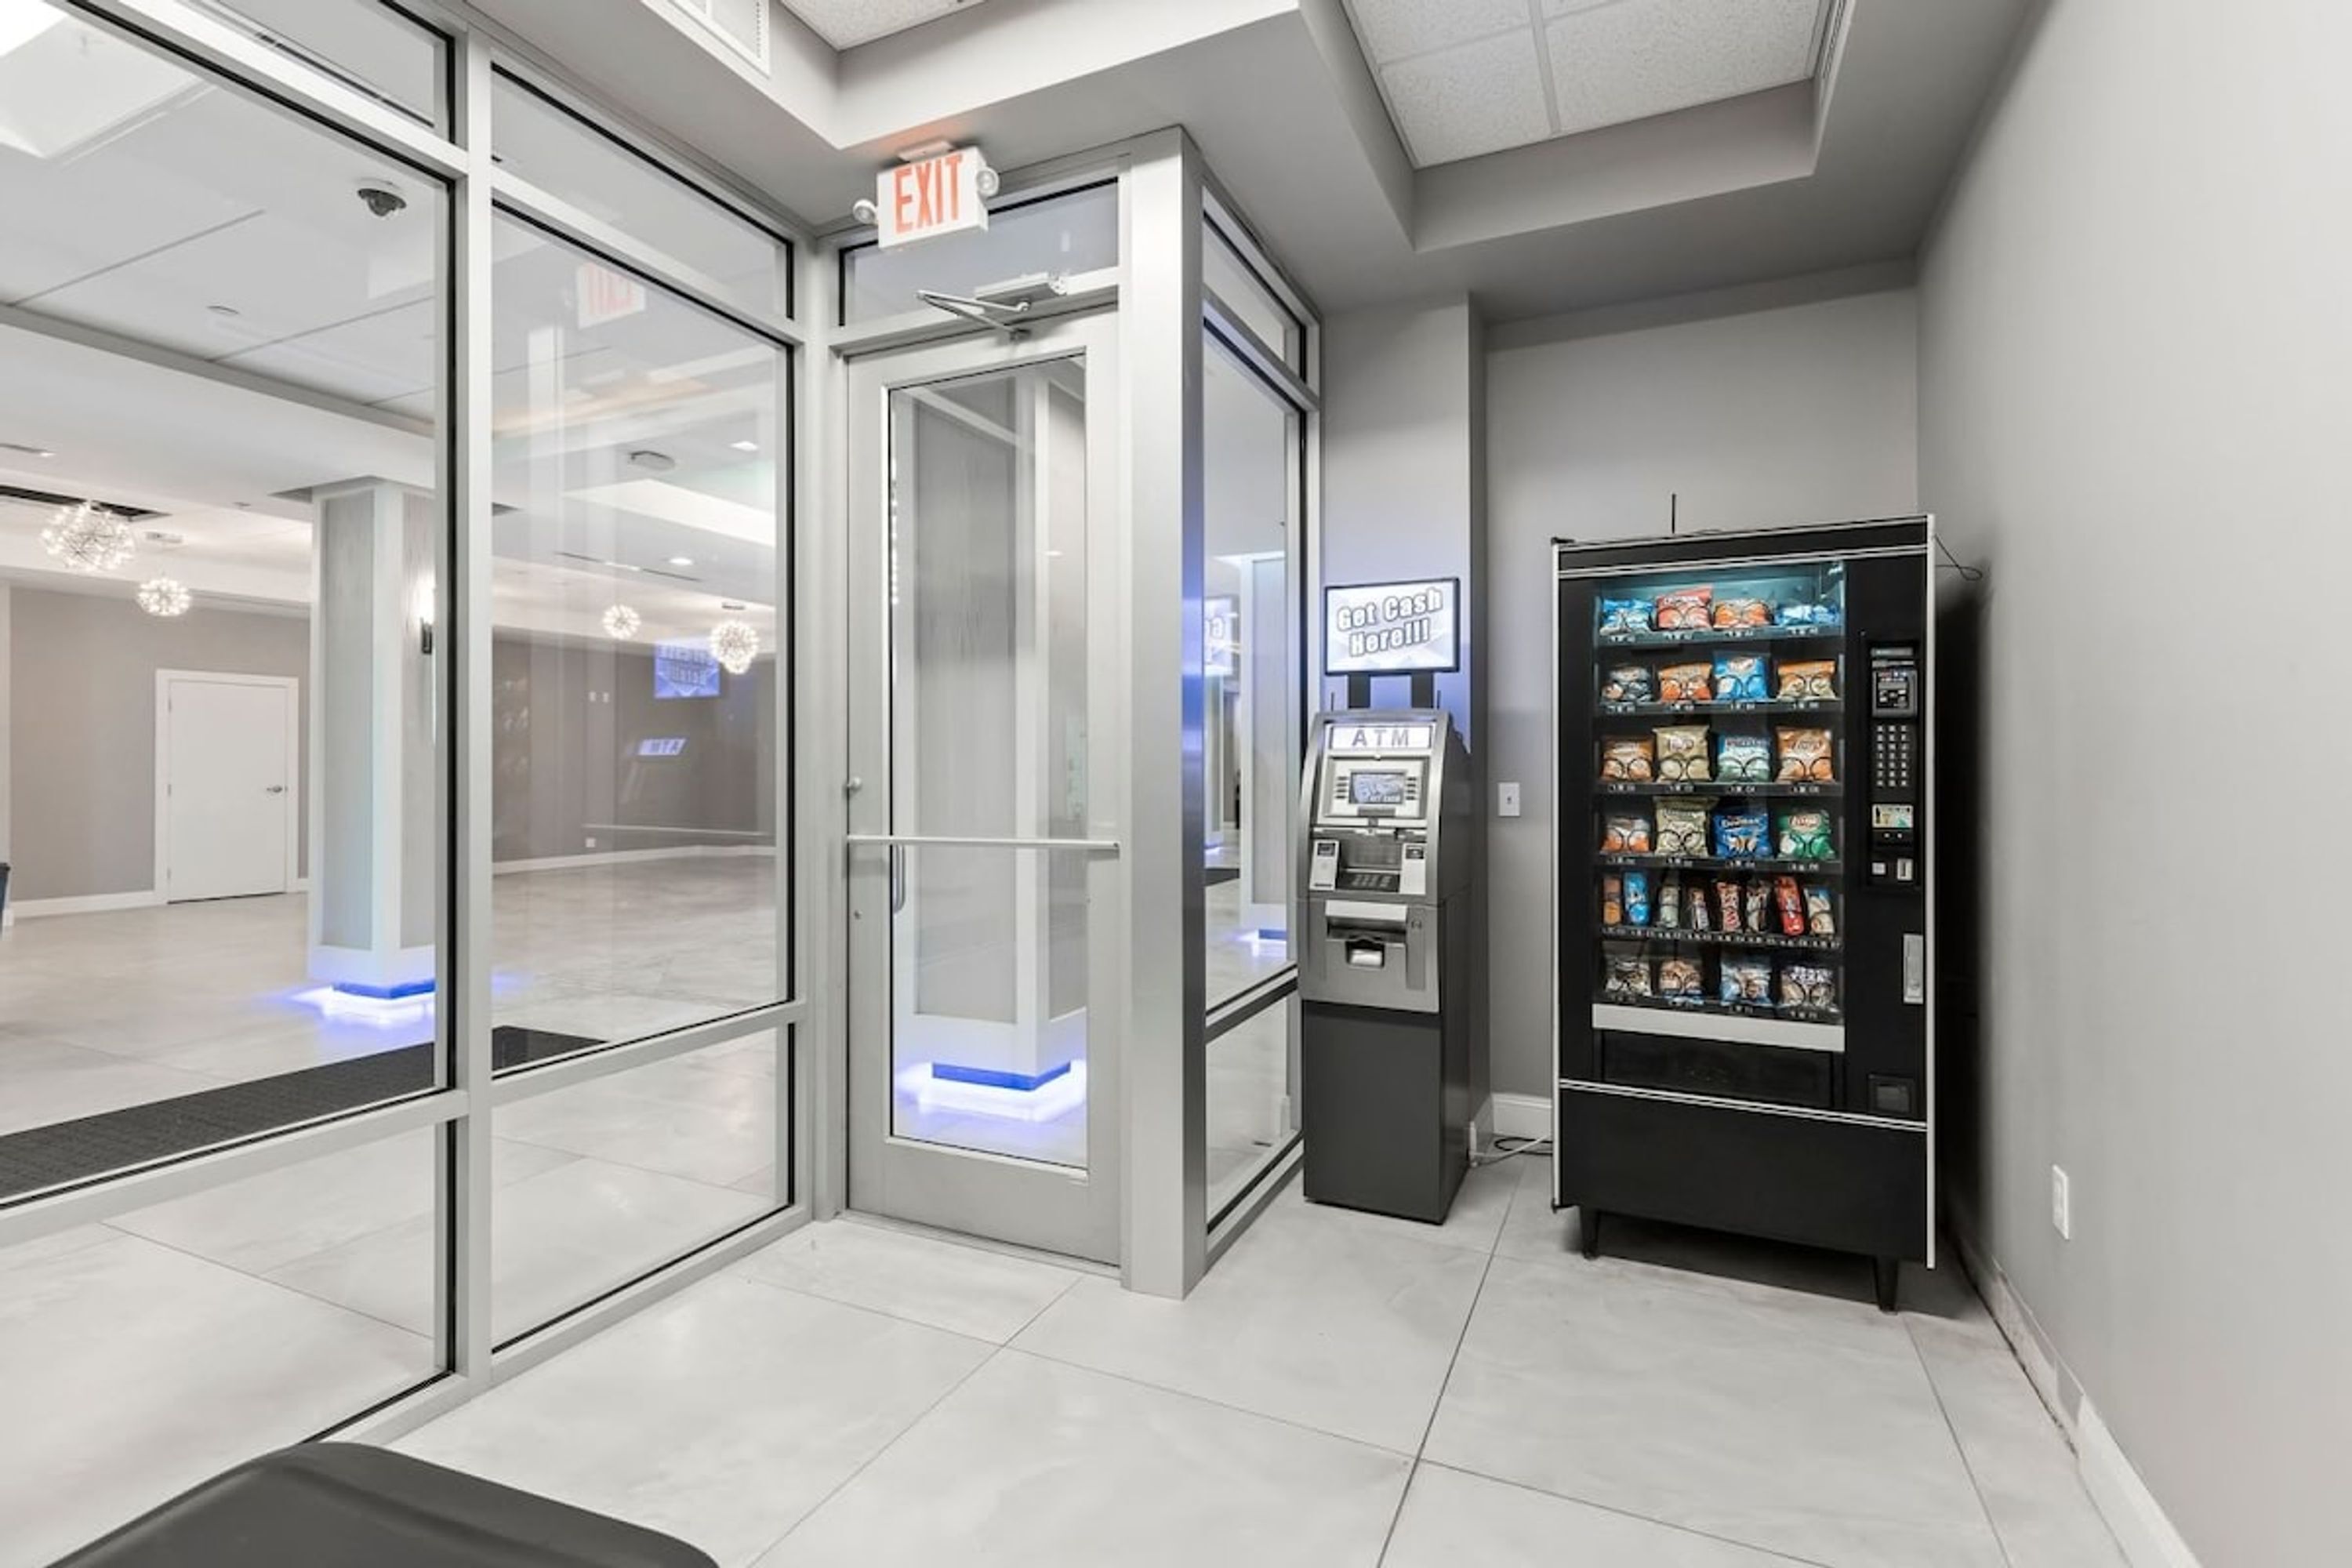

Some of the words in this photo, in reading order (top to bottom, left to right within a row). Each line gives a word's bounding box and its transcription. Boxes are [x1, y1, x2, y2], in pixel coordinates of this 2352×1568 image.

[895, 153, 964, 234] EXIT
[1338, 603, 1377, 631] Get
[1384, 587, 1442, 621] Cash
[1352, 728, 1410, 746] ATM
